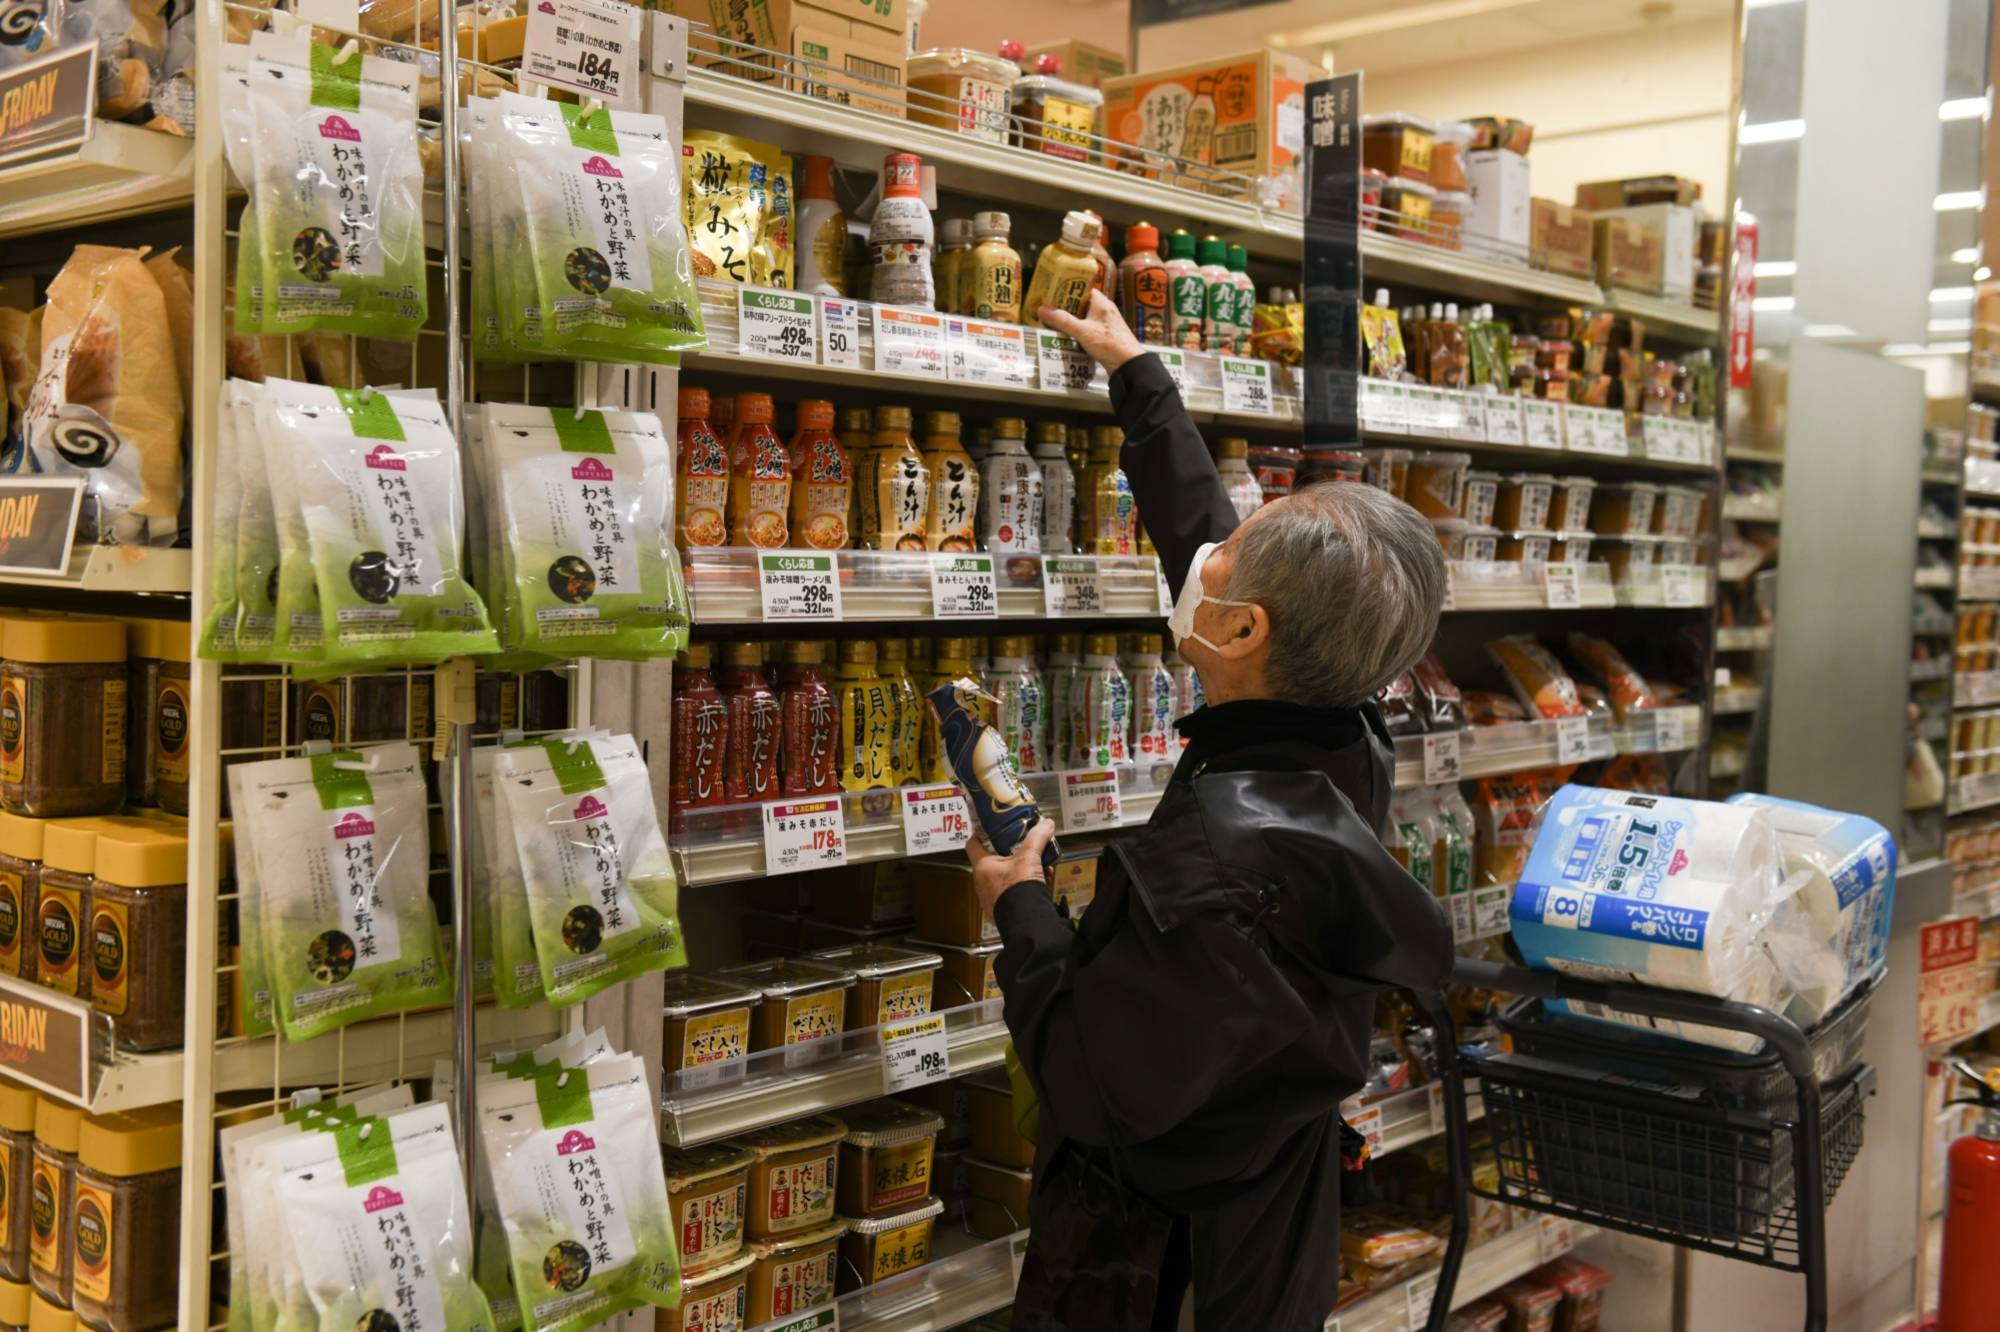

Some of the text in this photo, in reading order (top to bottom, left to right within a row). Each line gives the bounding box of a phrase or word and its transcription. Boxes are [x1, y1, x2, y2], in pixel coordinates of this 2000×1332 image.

[3, 68, 58, 129] FRIDAY
[1312, 92, 1335, 147] 味噌
[596, 178, 632, 281] わかめと野菜
[612, 181, 637, 242] 味噌汁の具
[699, 151, 747, 282] 粒みそ
[758, 294, 796, 311] くらし応援
[829, 332, 847, 352] 50
[394, 476, 425, 540] 味噌汁の具
[599, 485, 625, 544] 味噌汁の具
[946, 460, 967, 525] とん汁
[1014, 461, 1031, 550] 健康みそ汁
[377, 473, 422, 587] わかめと野菜
[581, 484, 617, 586] わかめと野菜
[778, 558, 815, 570] くらし応援
[160, 717, 183, 730] GOLD
[695, 700, 722, 799] 赤だし
[752, 698, 774, 793] 赤だし
[809, 692, 833, 788] 赤だし
[868, 686, 888, 780] 貝だし
[779, 817, 836, 831] 液みそ赤だし
[1636, 820, 1684, 901] シャワートイレ用
[42, 926, 69, 943] GOLD
[1554, 896, 1579, 917] 8
[1580, 896, 1594, 927] ダブル
[1625, 904, 1694, 927] コンパクト
[94, 941, 119, 957] GOLD
[793, 1013, 837, 1035] だし入り
[886, 993, 926, 1013] だし入り
[691, 1033, 740, 1056] だし入り
[583, 1155, 615, 1218] 味噌汁の具
[878, 1158, 927, 1190] 京懐石
[567, 1157, 613, 1266] わかめと野菜
[377, 1215, 423, 1332] わかめと野菜
[877, 1241, 926, 1274] 京懐石
